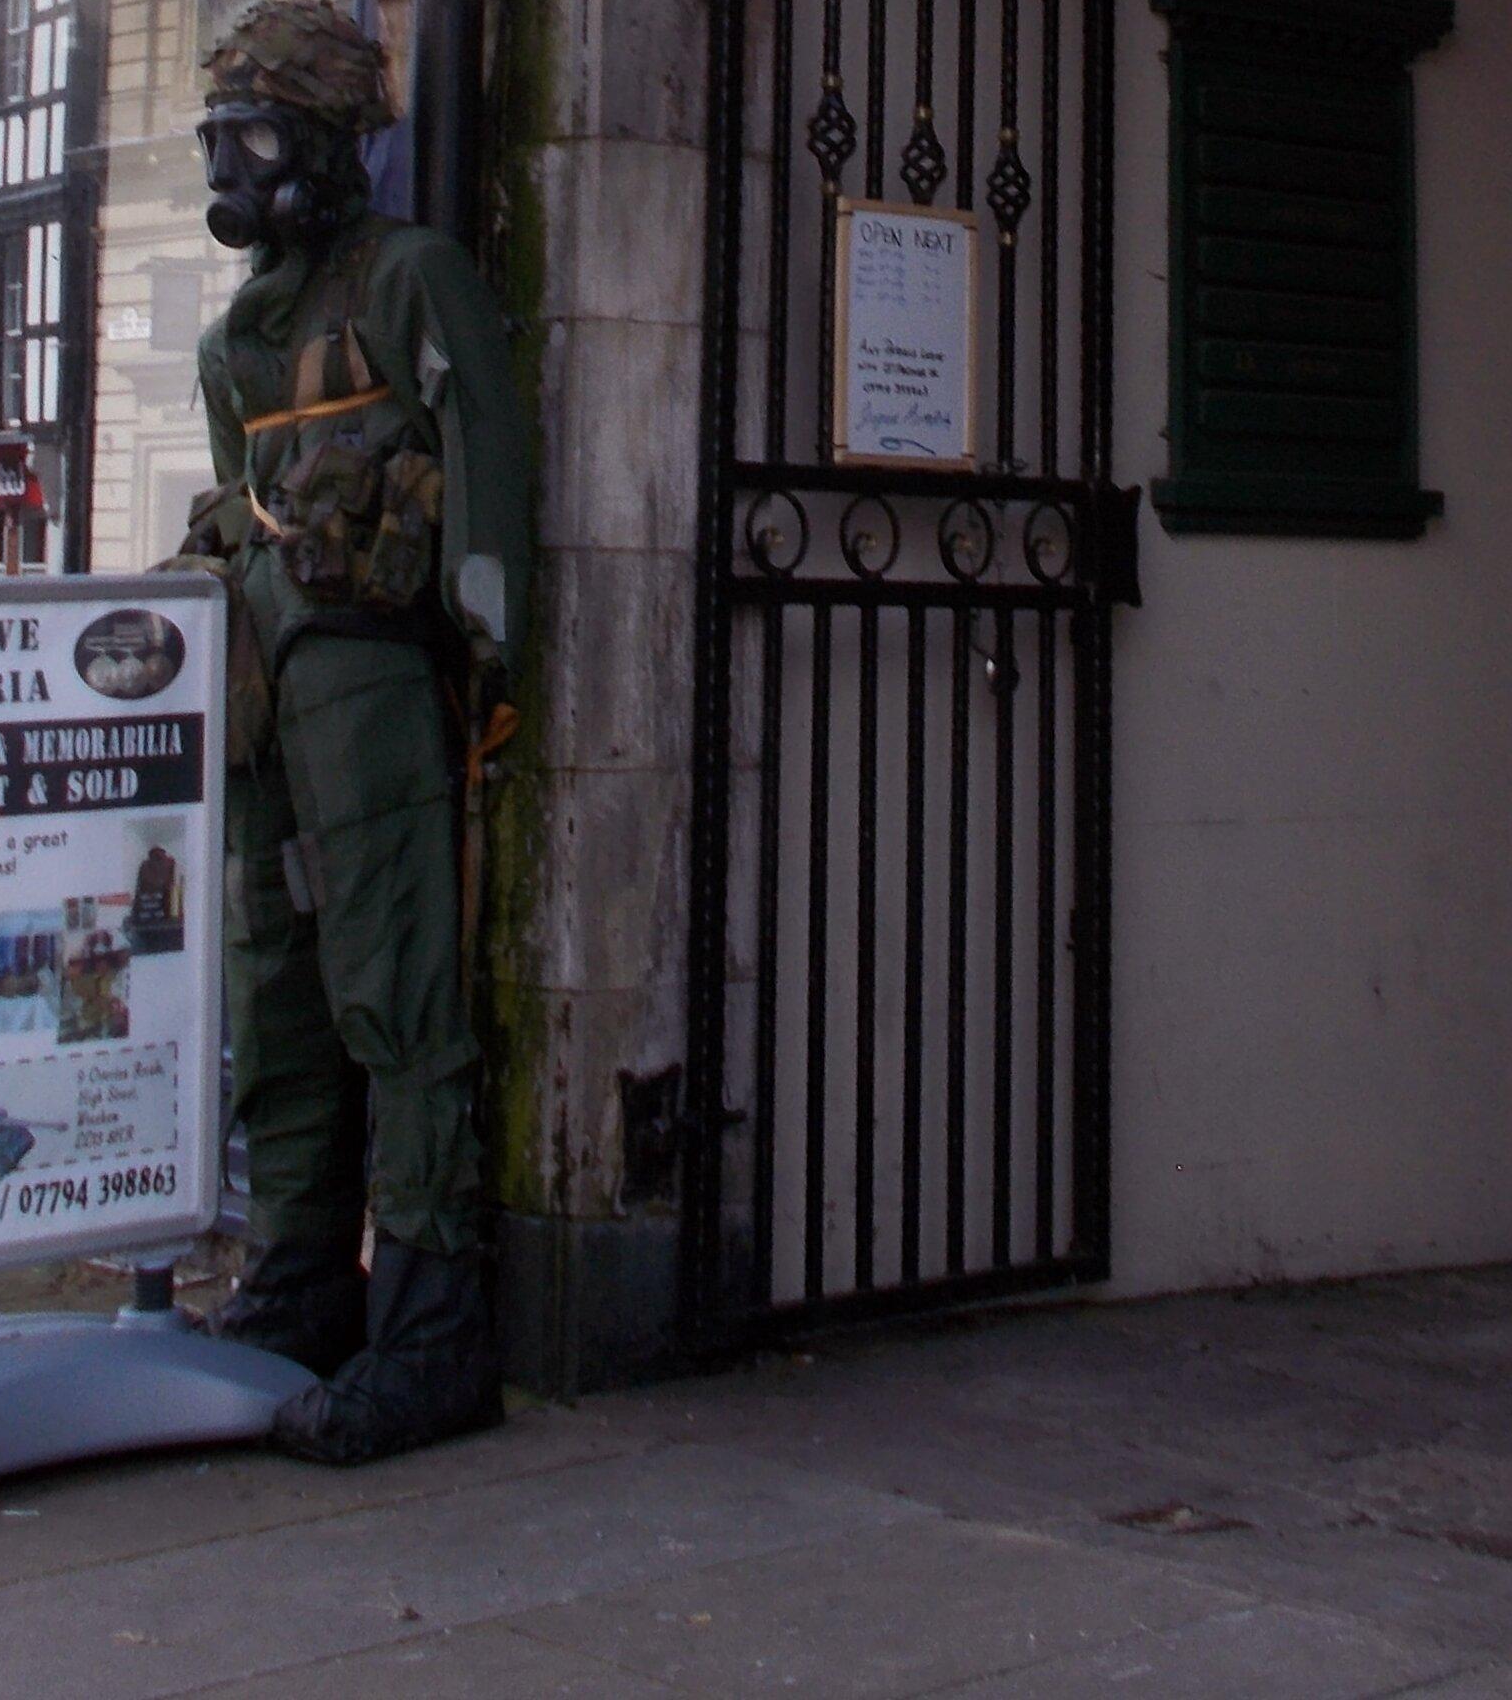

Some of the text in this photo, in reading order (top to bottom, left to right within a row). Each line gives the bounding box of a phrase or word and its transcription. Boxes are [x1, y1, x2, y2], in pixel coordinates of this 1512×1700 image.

[860, 220, 903, 248] OPEN
[22, 721, 183, 765] MEMORABILIA
[27, 771, 49, 806] &
[66, 766, 140, 801] SOLD
[6, 835, 17, 850] a
[23, 830, 69, 855] great
[19, 1175, 89, 1215] 07794
[97, 1163, 178, 1205] 398863
